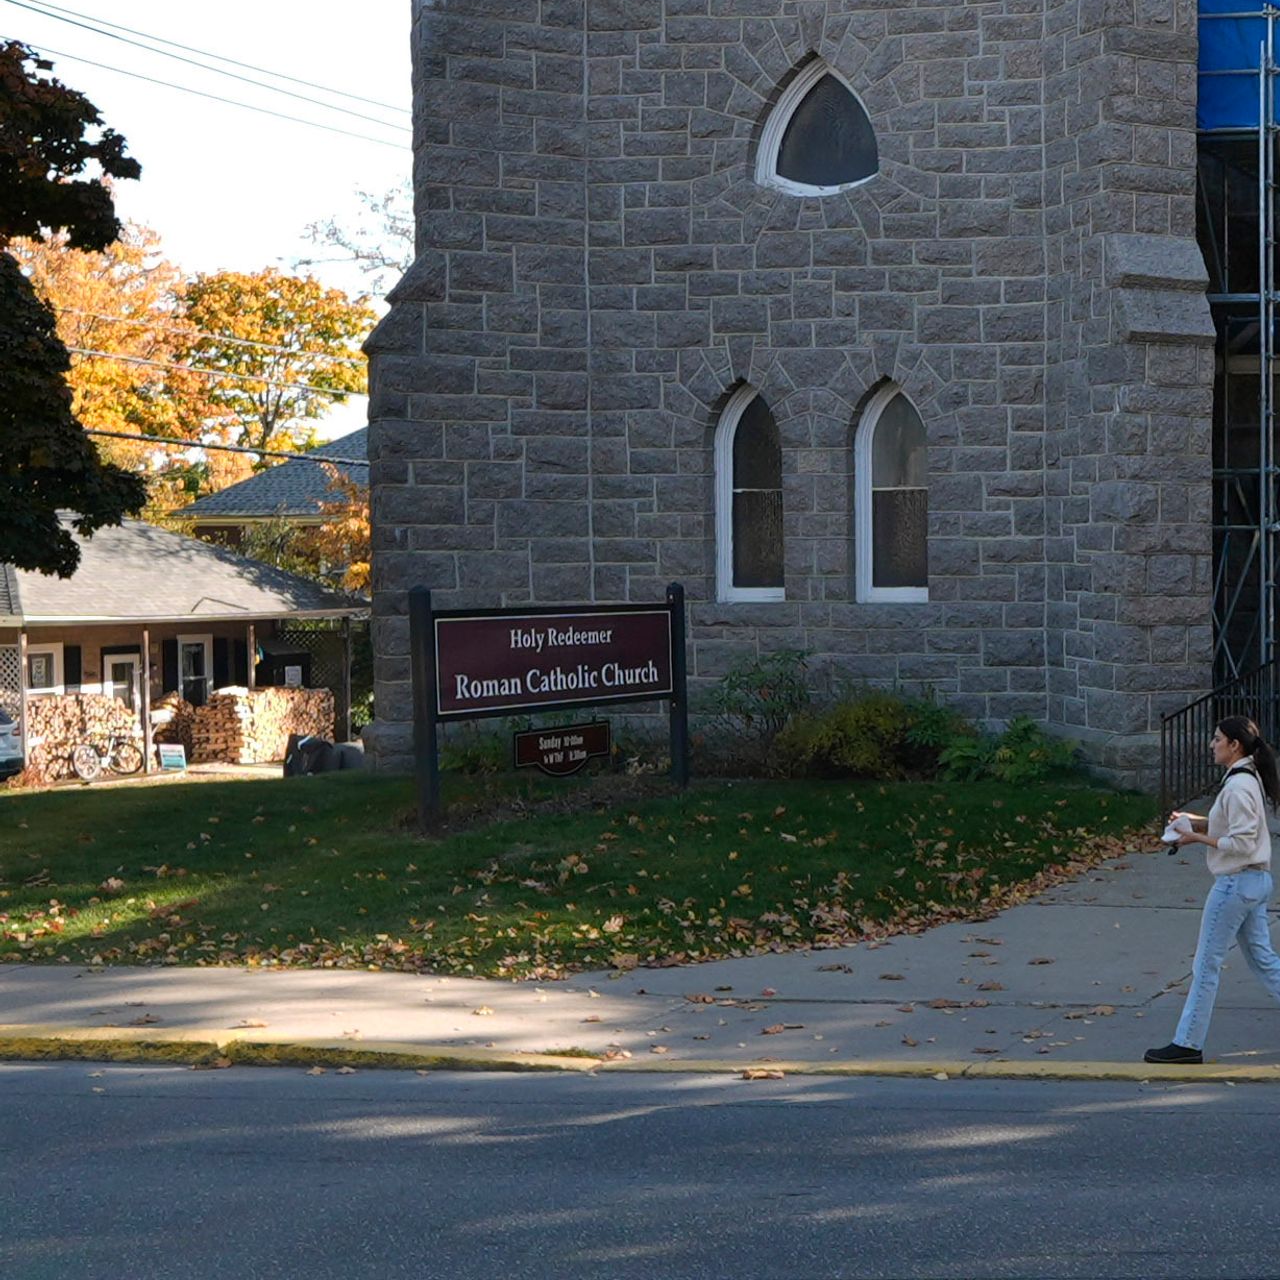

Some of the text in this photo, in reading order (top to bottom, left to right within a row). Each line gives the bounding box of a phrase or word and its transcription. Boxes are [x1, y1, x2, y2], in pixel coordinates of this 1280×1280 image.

[510, 626, 612, 653] Holy Redeemer
[454, 659, 659, 699] Roman Catholic Church
[539, 736, 561, 750] Sunday
